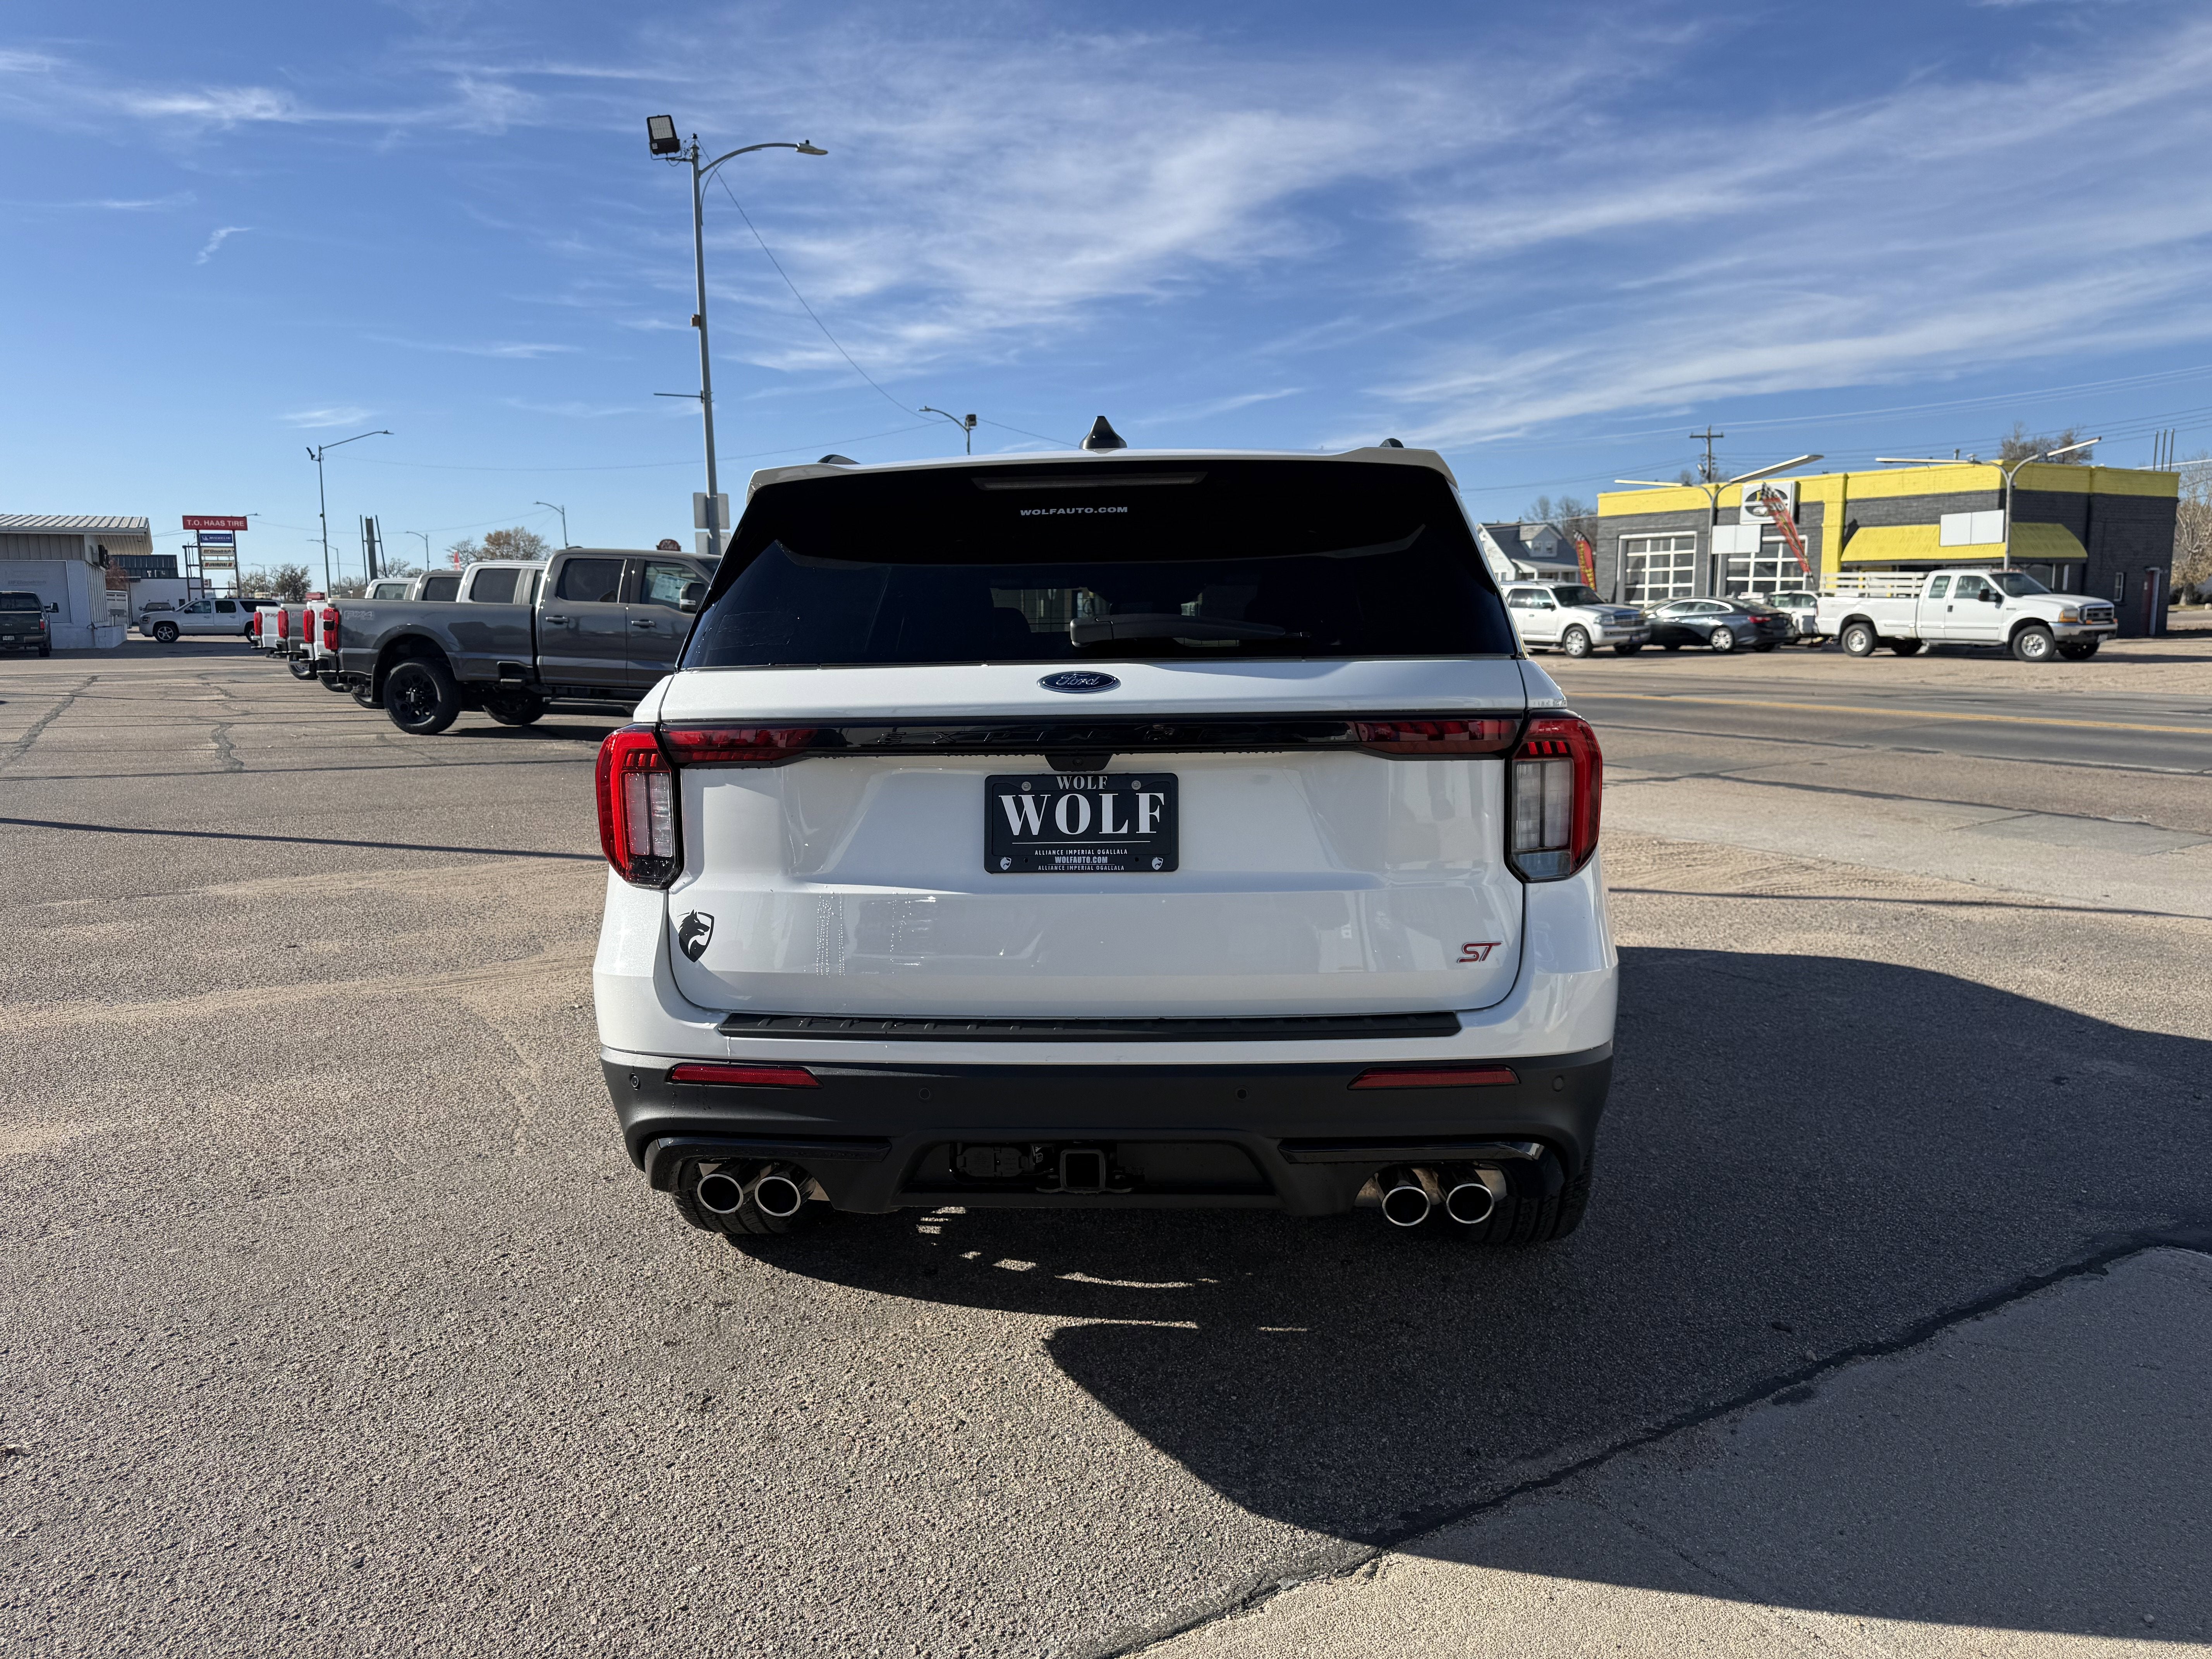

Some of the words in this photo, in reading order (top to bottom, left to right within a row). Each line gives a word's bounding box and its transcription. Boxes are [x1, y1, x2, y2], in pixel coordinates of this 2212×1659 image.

[1020, 507, 1127, 515] WOLFAUTO.COM
[1056, 673, 1101, 685] Ford
[1056, 776, 1107, 789] WOLF
[998, 793, 1164, 835] WOLF
[1456, 941, 1503, 963] ST
